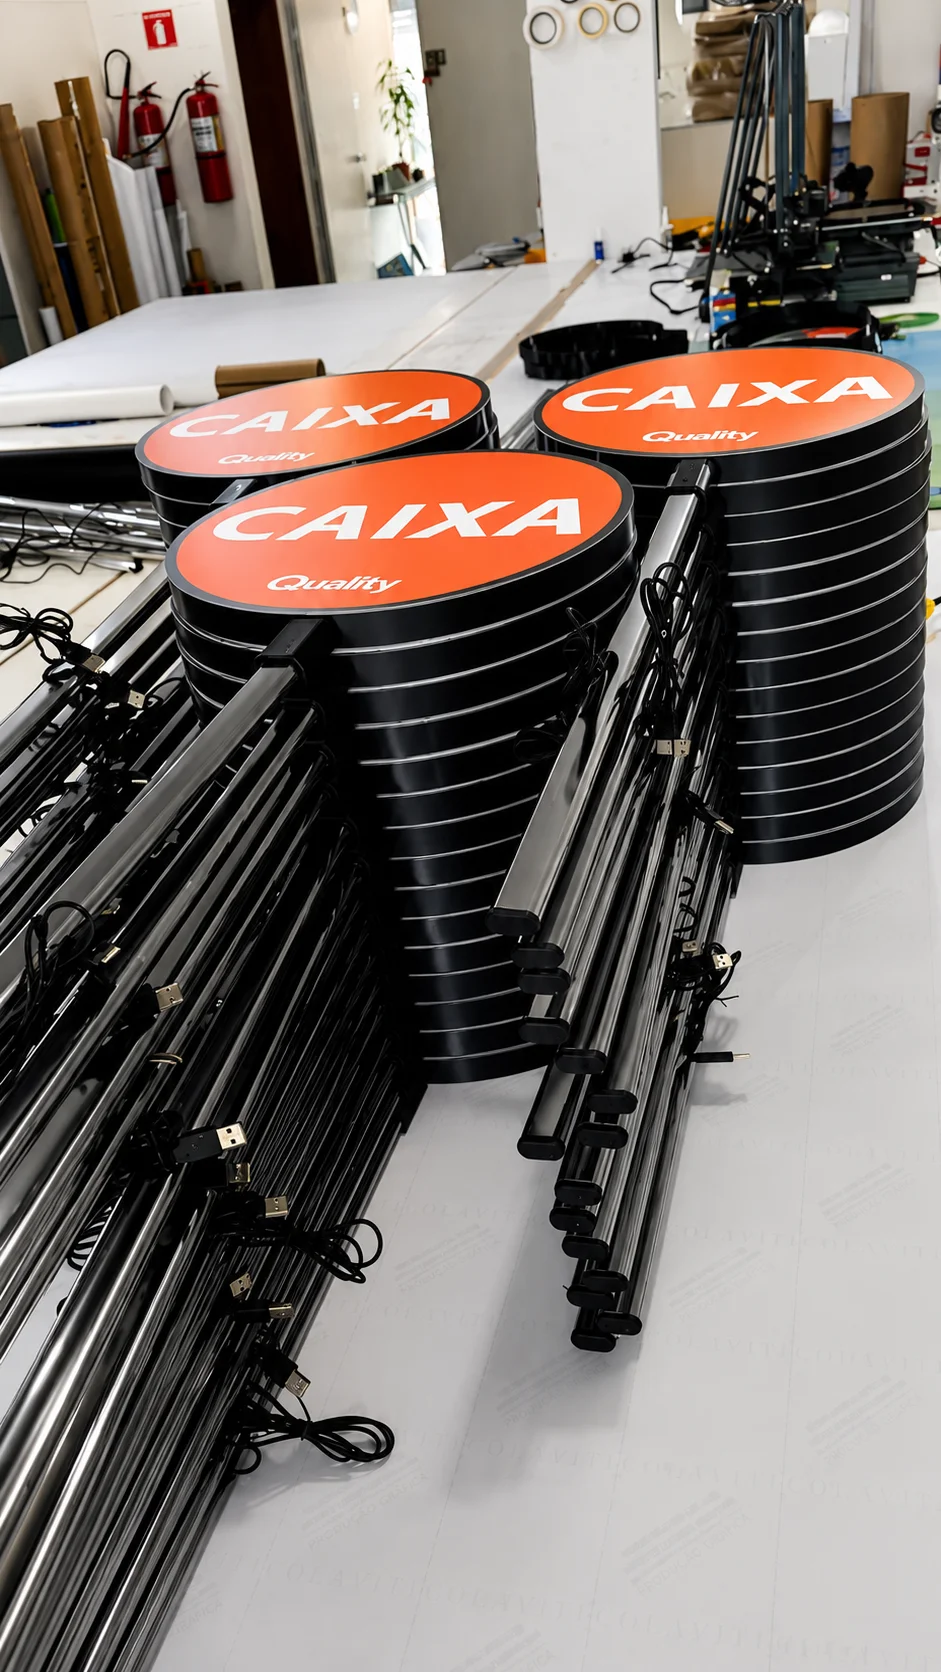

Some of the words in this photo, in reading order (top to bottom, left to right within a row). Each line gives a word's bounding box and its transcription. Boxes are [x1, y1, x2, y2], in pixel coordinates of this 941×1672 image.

[562, 376, 894, 413] CAIXA
[170, 397, 450, 439] CAIXA
[642, 430, 758, 444] Quality
[217, 449, 315, 466] Quality
[212, 498, 581, 541] CAIXA
[266, 574, 402, 594] Quality
